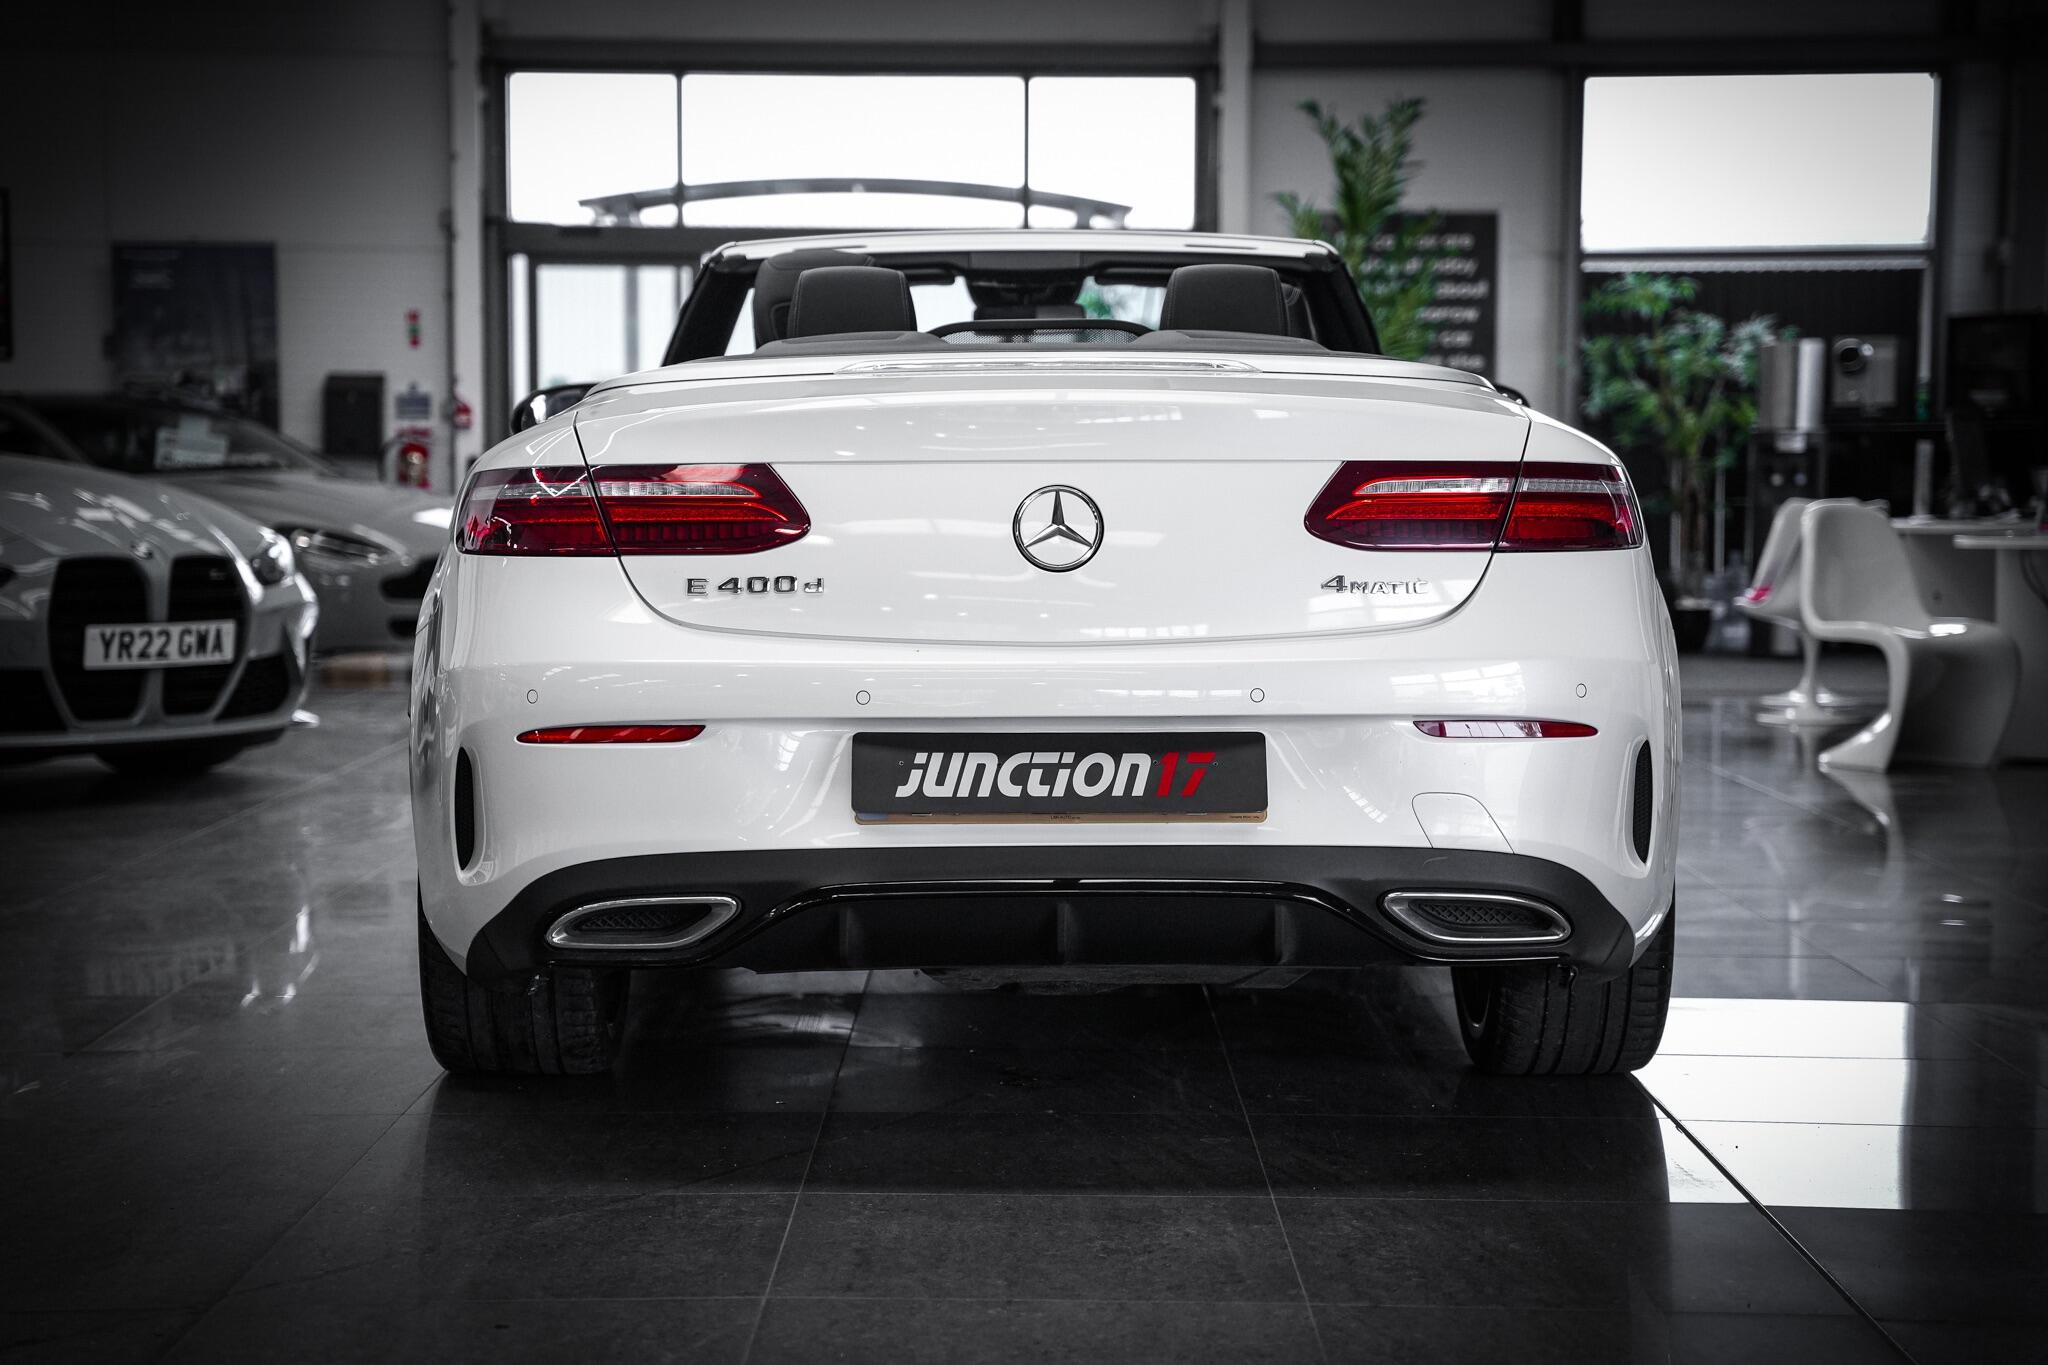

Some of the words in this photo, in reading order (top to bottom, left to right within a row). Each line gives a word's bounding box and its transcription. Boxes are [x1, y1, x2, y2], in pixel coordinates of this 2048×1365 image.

[686, 577, 709, 596] E
[1320, 575, 1429, 595] 4MATIC
[100, 629, 171, 661] YR22
[178, 627, 224, 659] GWA
